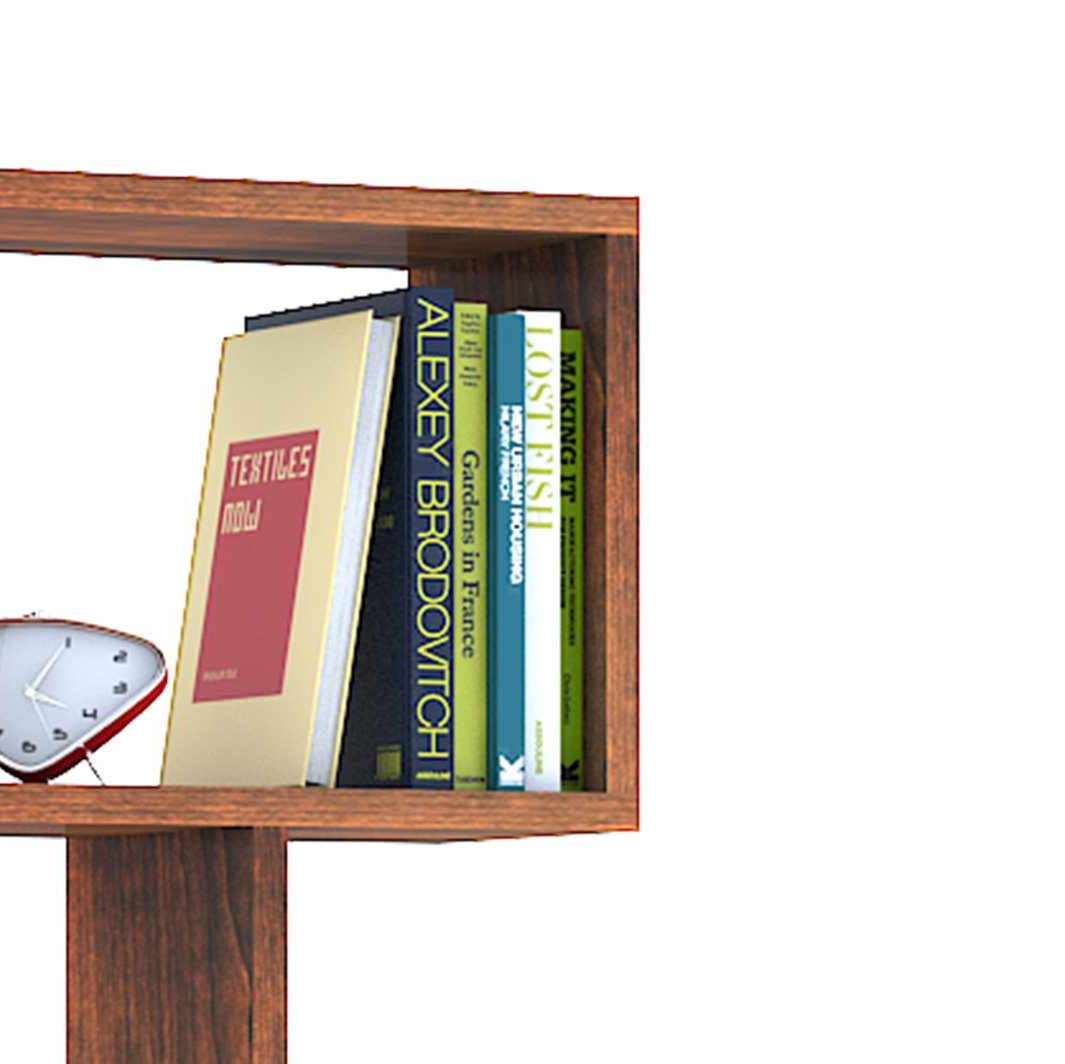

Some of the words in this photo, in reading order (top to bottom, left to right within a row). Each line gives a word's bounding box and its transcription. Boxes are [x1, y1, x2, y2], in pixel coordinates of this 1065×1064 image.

[417, 298, 450, 467] ALEXEY
[526, 327, 553, 430] LOST
[510, 404, 523, 444] NEW
[561, 351, 576, 466] MAKING
[230, 445, 312, 487] TEXTILES
[499, 450, 511, 501] FRENCH
[510, 447, 523, 505] URBAN
[526, 443, 553, 529] FISH
[561, 472, 575, 503] IT
[221, 499, 262, 535] NOW
[461, 450, 480, 545] Gardens
[462, 551, 480, 573] in
[509, 508, 524, 585] HOUSING
[416, 480, 451, 758] BRODOVITCH
[462, 579, 480, 659] France
[65, 637, 72, 648] 1
[113, 650, 129, 663] 2
[53, 728, 68, 741] 5
[82, 708, 98, 720] 4
[22, 741, 37, 753] 6
